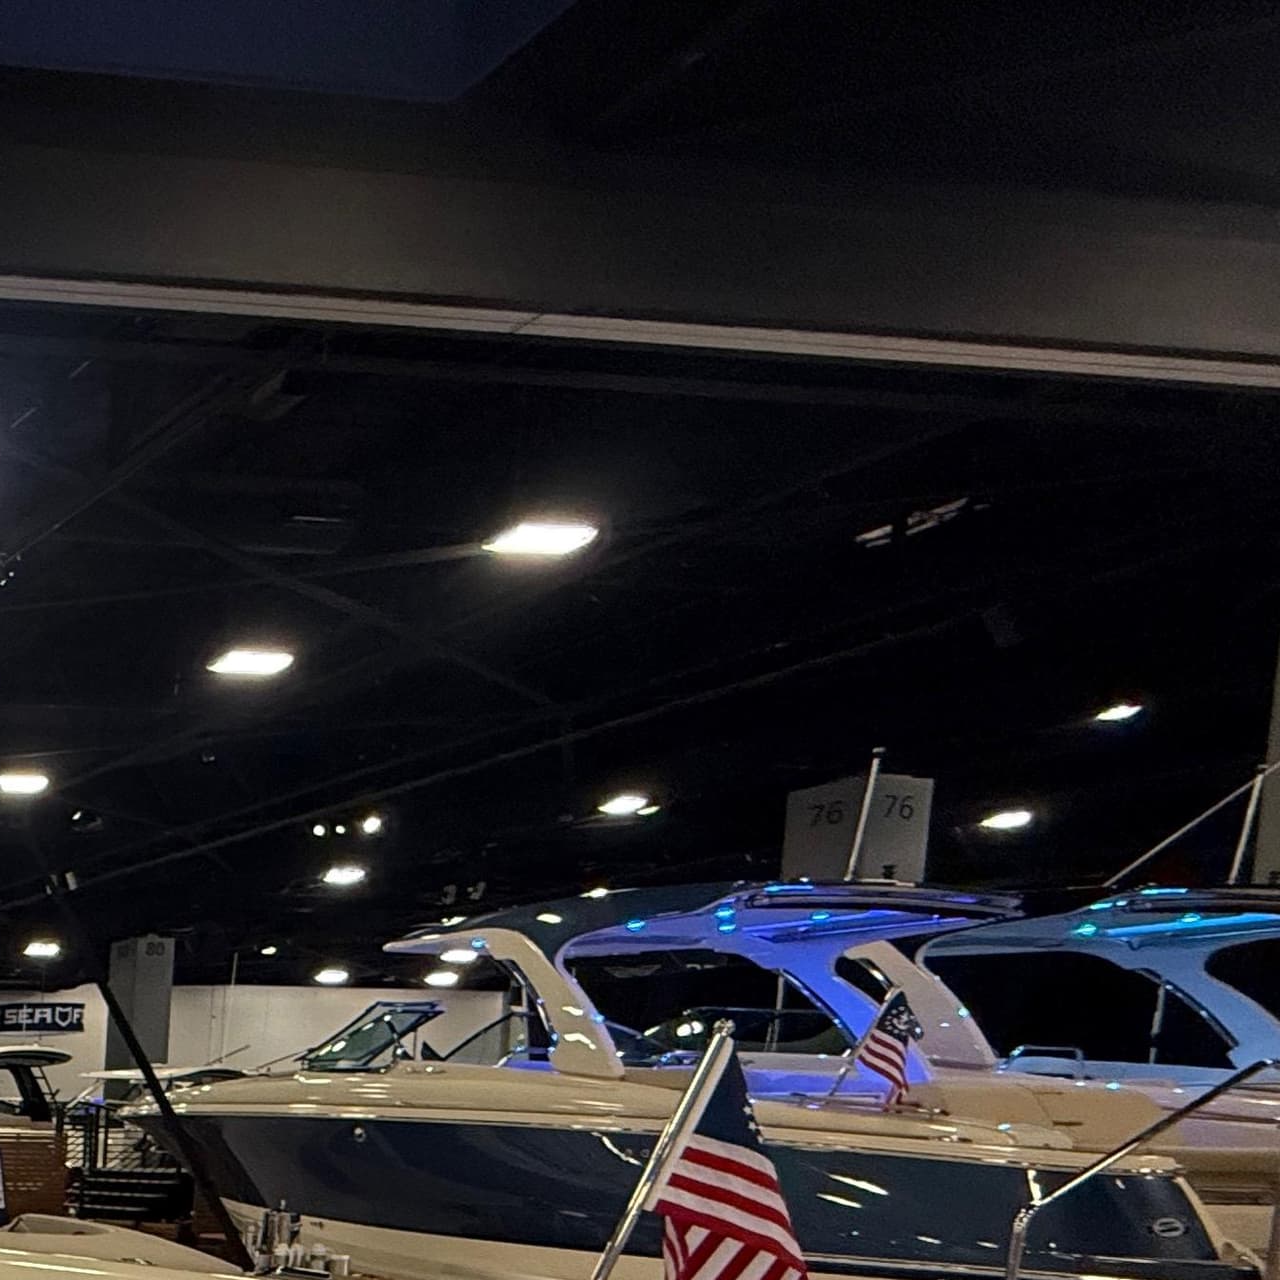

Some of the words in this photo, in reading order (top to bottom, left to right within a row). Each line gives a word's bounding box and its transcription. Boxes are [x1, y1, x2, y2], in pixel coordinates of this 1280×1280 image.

[807, 801, 844, 826] 76
[882, 795, 914, 820] 76
[4, 1008, 52, 1025] SEA
